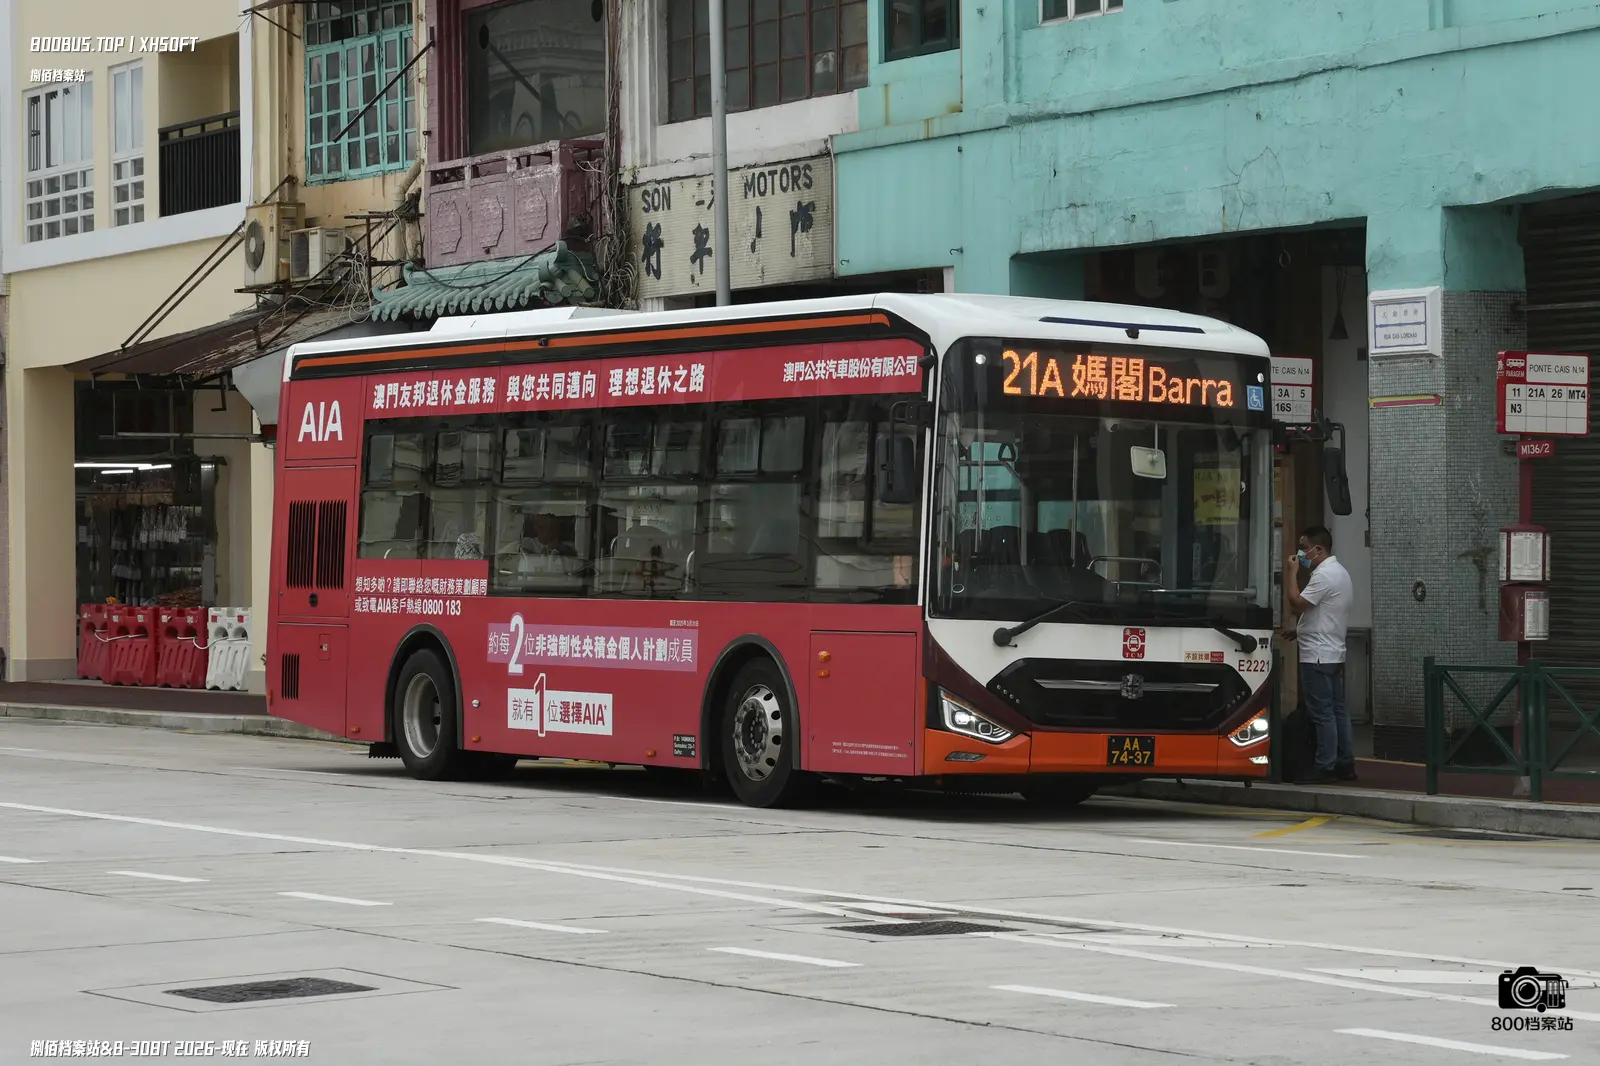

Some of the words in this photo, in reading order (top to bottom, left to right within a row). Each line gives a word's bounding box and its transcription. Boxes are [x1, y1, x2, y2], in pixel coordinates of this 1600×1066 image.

[641, 186, 672, 213] SON
[744, 163, 813, 199] MOTORS
[783, 355, 918, 383] 澳門公共汽車股份有限公司
[1281, 366, 1296, 375] CAIS
[1529, 364, 1552, 373] PONTE
[1554, 364, 1570, 374] CAIS
[1002, 349, 1064, 397] 21A
[1071, 354, 1144, 401] 媽閣
[1149, 366, 1233, 407] Barra
[373, 377, 496, 410] 澳門友邦退休金服務
[506, 369, 597, 403] 與您共同邁向
[608, 362, 705, 397] 理想退休之路
[1277, 388, 1290, 398] 3A
[1300, 389, 1306, 398] 5
[1512, 387, 1521, 397] 11
[1528, 387, 1546, 398] 21A
[1551, 388, 1563, 399] 26
[1568, 389, 1586, 400] MT4
[1275, 403, 1292, 412] 16S
[1510, 403, 1522, 414] N3
[297, 400, 343, 442] AIA
[445, 600, 461, 615] 183
[1238, 659, 1270, 673] E2221
[1123, 737, 1140, 751] AA
[1111, 750, 1151, 764] 74-37
